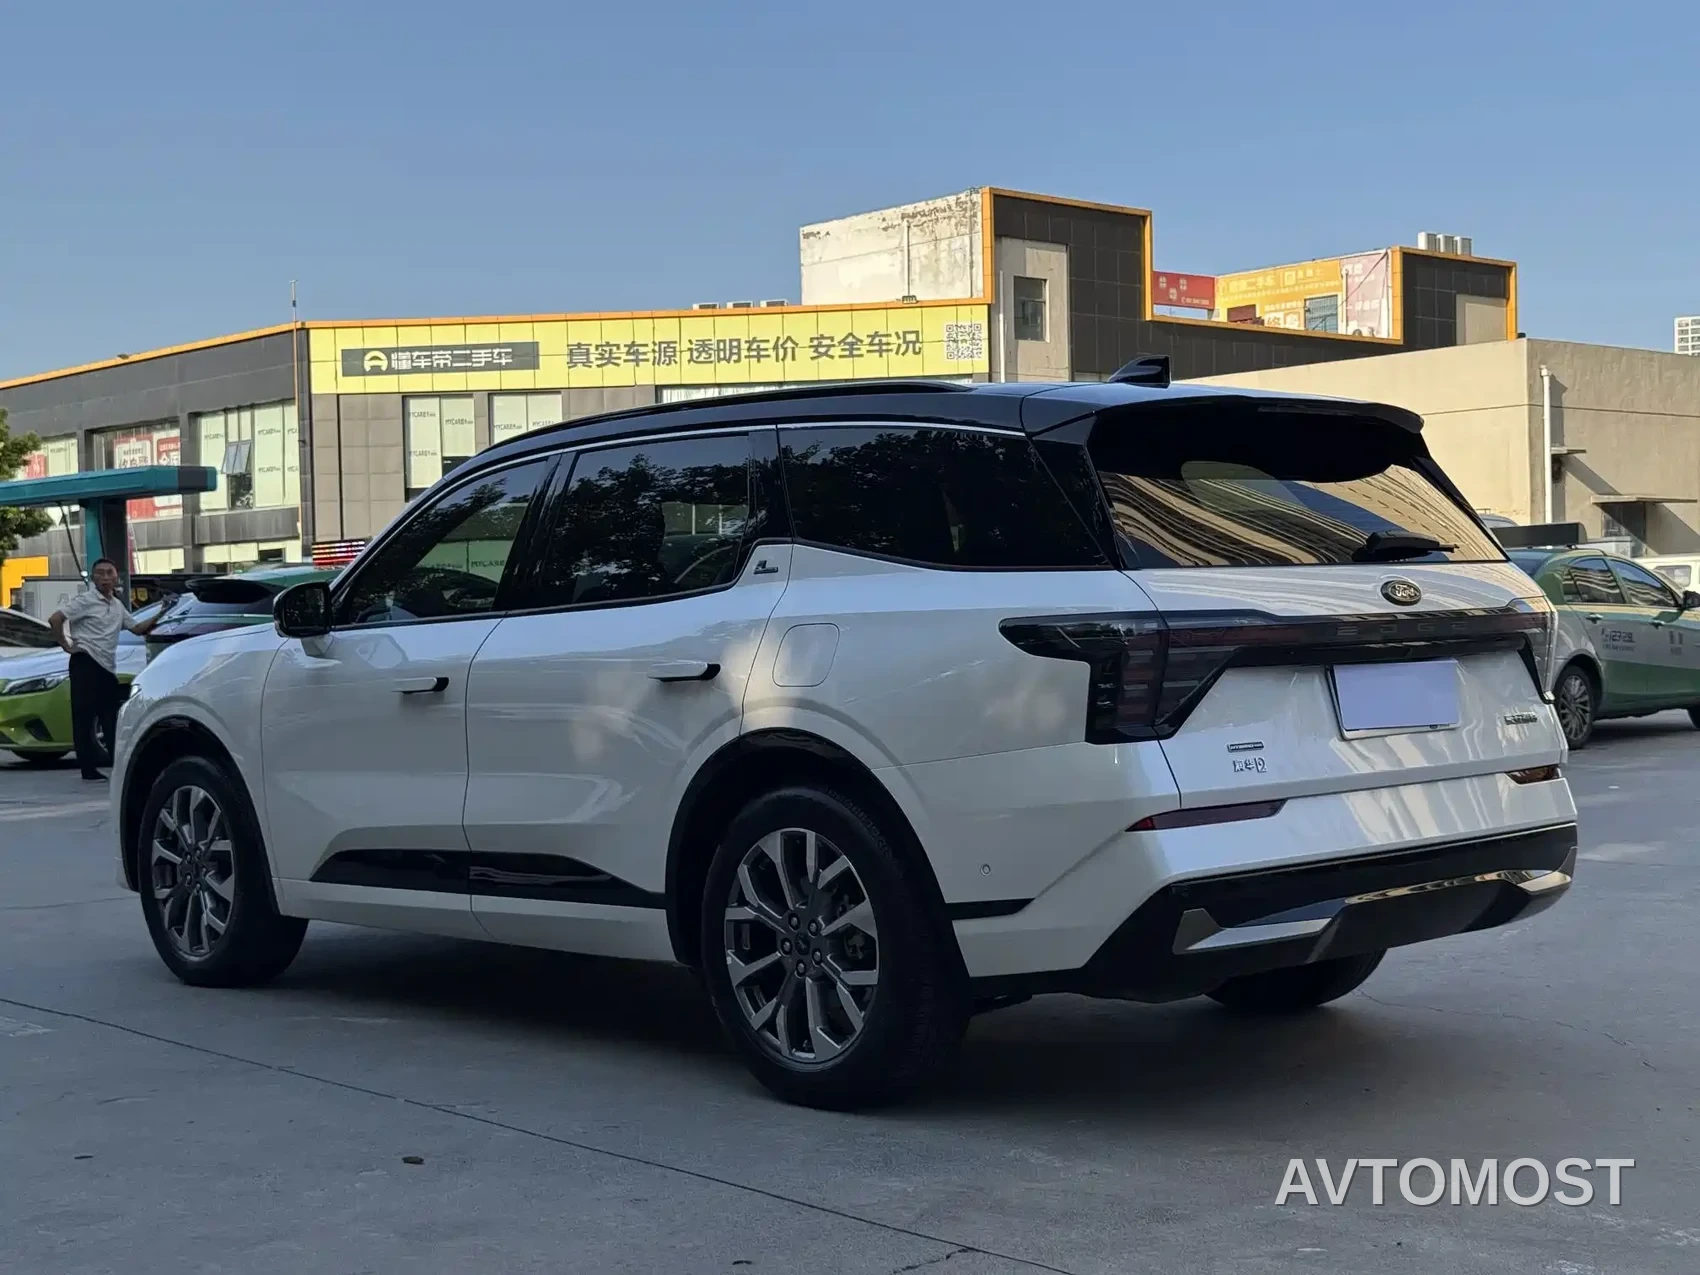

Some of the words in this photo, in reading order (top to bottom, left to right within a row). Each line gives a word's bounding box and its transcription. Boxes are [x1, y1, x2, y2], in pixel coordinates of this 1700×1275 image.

[390, 348, 512, 370] 懂车帝二手车
[566, 340, 678, 369] 真实车源
[687, 335, 800, 364] 透明车价
[809, 330, 922, 361] 安全车况
